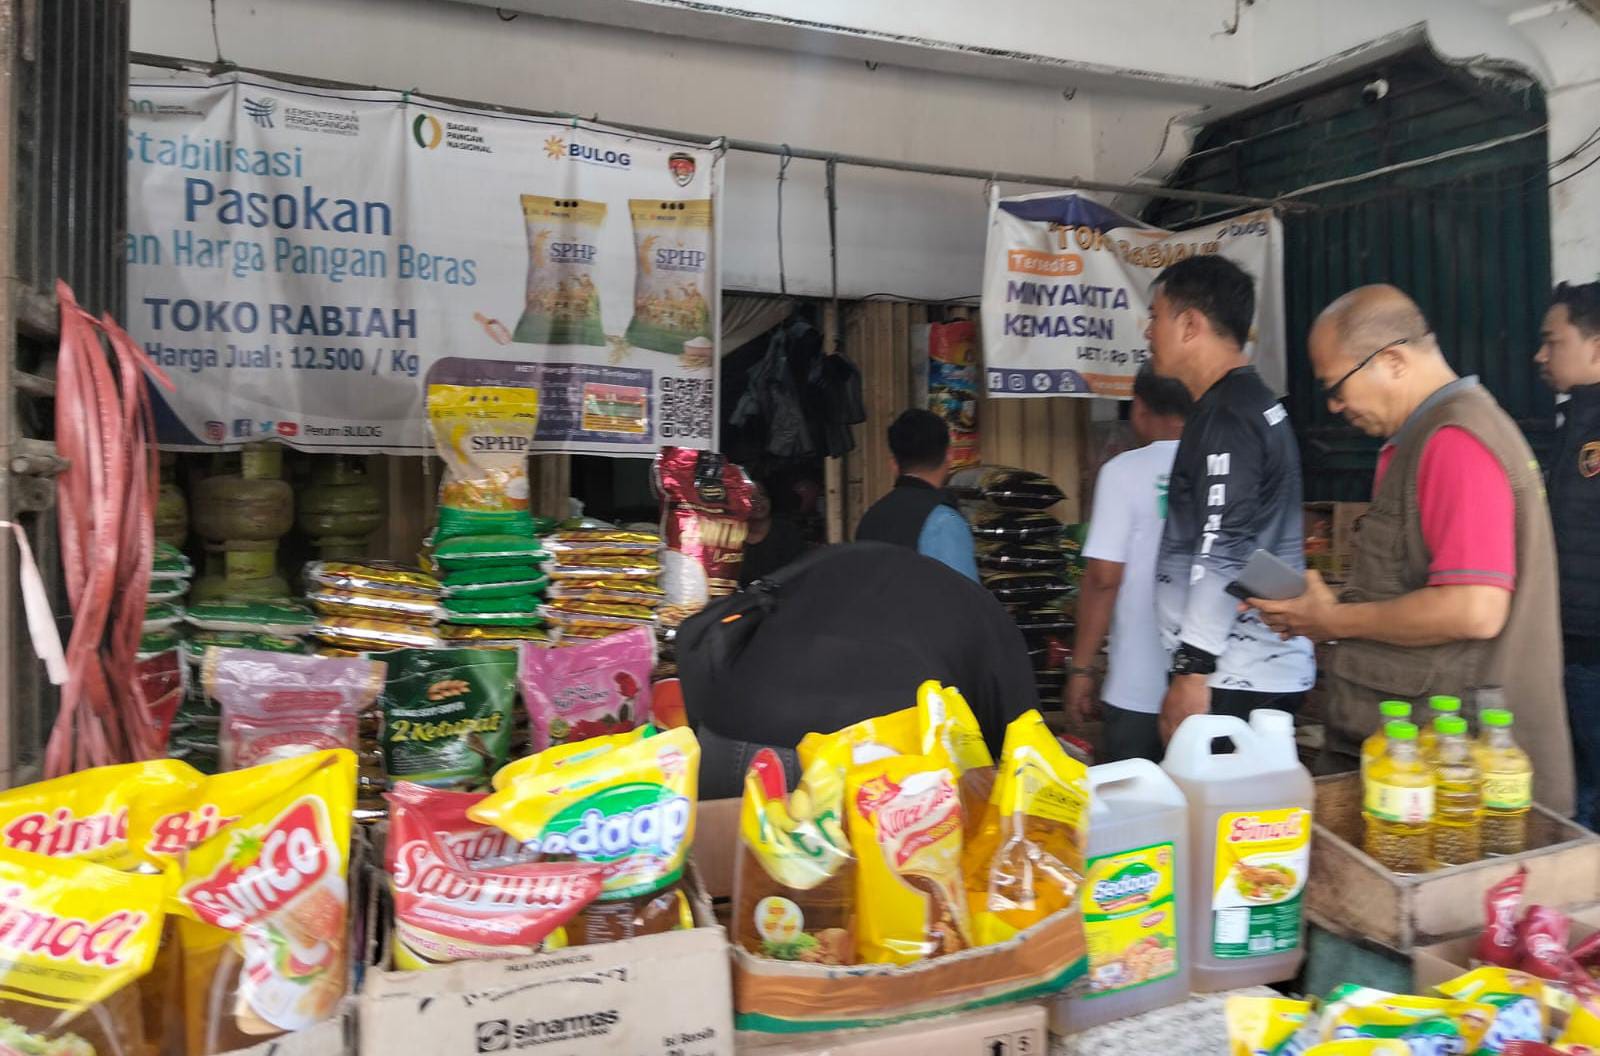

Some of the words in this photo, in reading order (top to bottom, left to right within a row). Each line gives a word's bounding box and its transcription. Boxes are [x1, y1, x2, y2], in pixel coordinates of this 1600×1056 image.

[128, 130, 303, 178] tabilisasi
[568, 143, 631, 167] BULOG
[184, 178, 391, 235] Pasokan
[174, 230, 264, 278] Harga
[274, 237, 387, 283] Pangan
[400, 244, 477, 286] Beras
[1006, 281, 1129, 310] MINYAKITA
[144, 298, 259, 334] TOKO
[270, 304, 417, 338] RABIAH
[1004, 313, 1114, 340] KEMASAN
[145, 342, 217, 373] Harga
[291, 347, 363, 371] 12.500
[391, 349, 419, 378] Kg
[472, 436, 528, 451] SPHP
[515, 1009, 619, 1039] sinarmas
